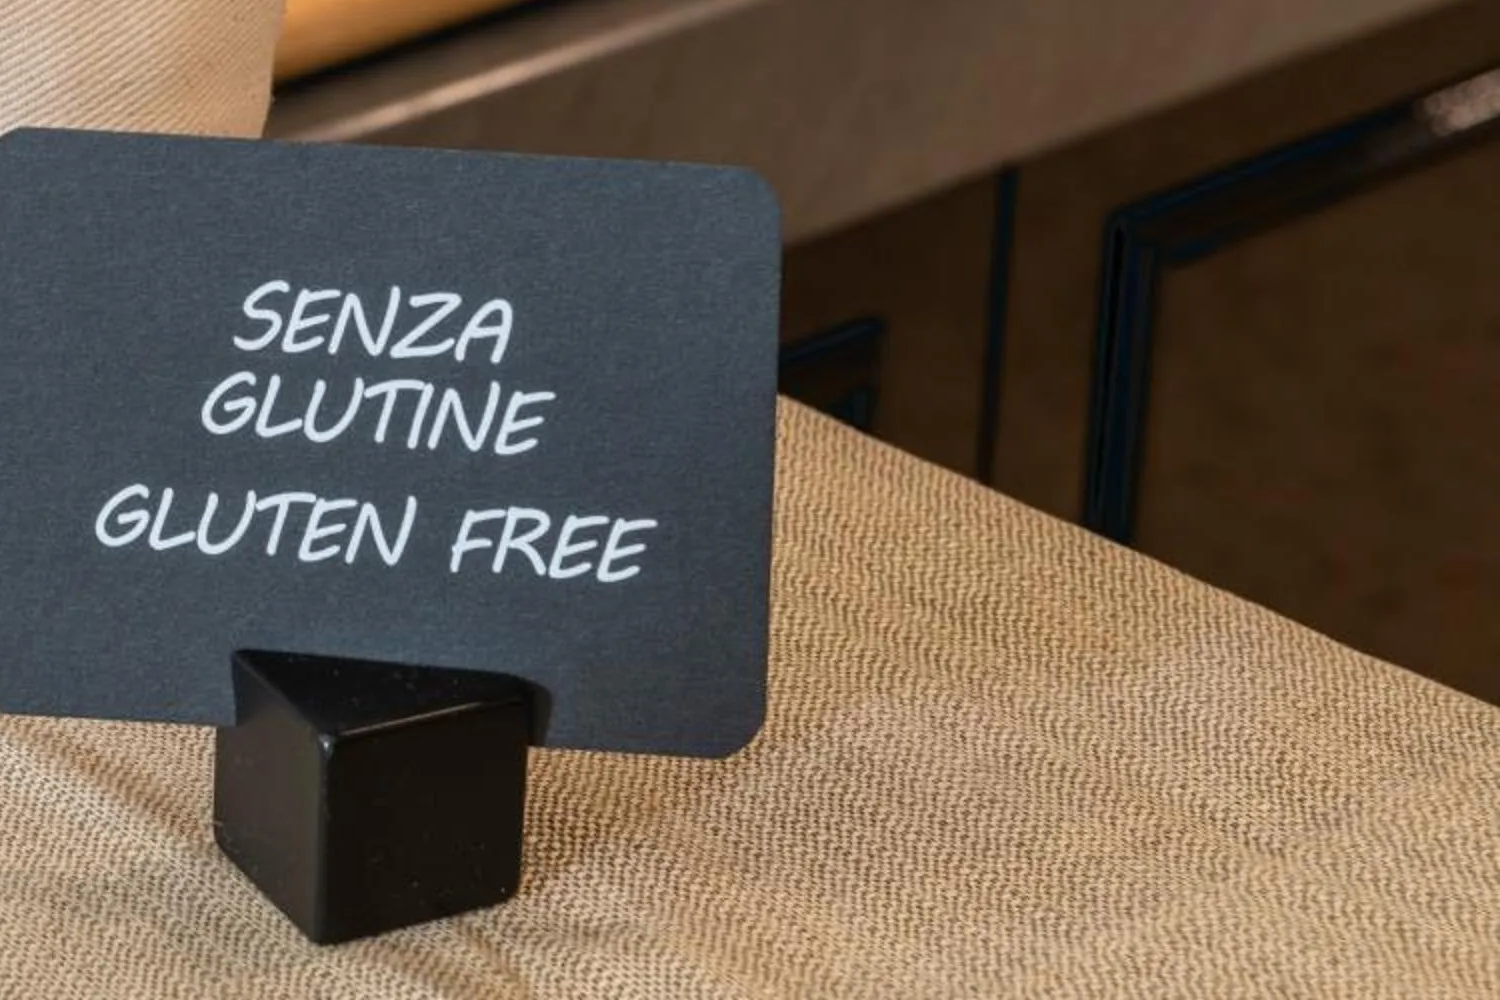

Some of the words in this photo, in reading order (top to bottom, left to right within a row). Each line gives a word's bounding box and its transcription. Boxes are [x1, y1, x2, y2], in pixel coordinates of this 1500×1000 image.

[233, 279, 514, 364] SENZA
[201, 371, 557, 456] GLUTINE
[95, 483, 418, 566] GLUTEN
[450, 506, 659, 583] FREE
